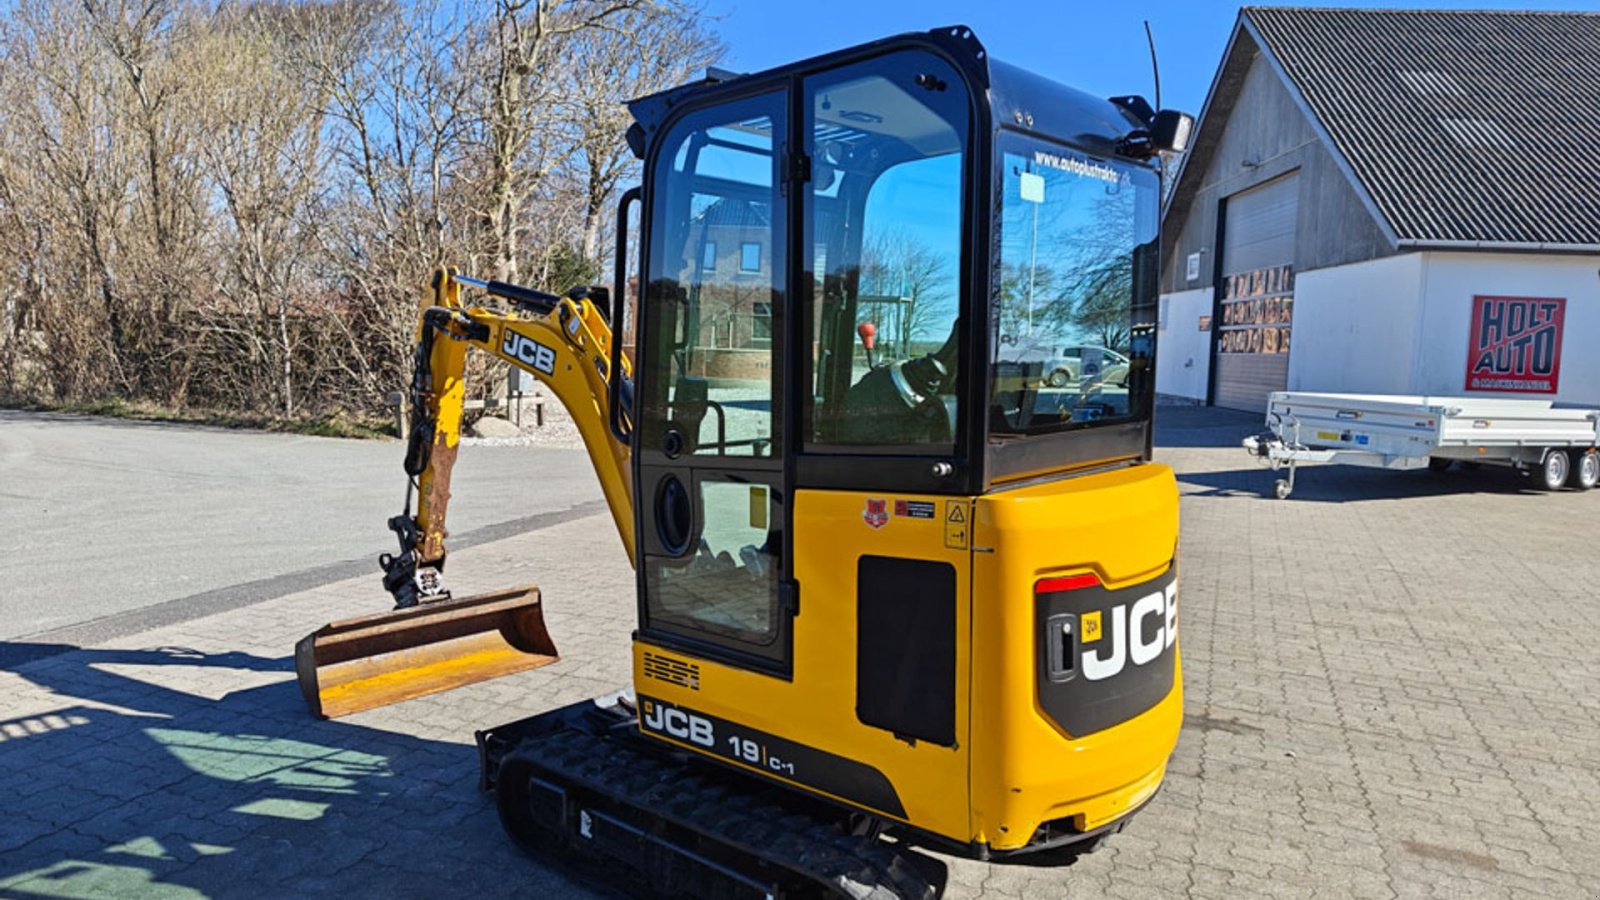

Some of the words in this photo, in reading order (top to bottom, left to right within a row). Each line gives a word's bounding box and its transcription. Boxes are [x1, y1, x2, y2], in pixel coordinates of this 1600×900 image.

[1473, 324, 1556, 375] AUTO
[1479, 300, 1559, 350] HOLT
[503, 333, 556, 374] JCB
[1081, 577, 1177, 681] JCB
[645, 704, 715, 747] JCB
